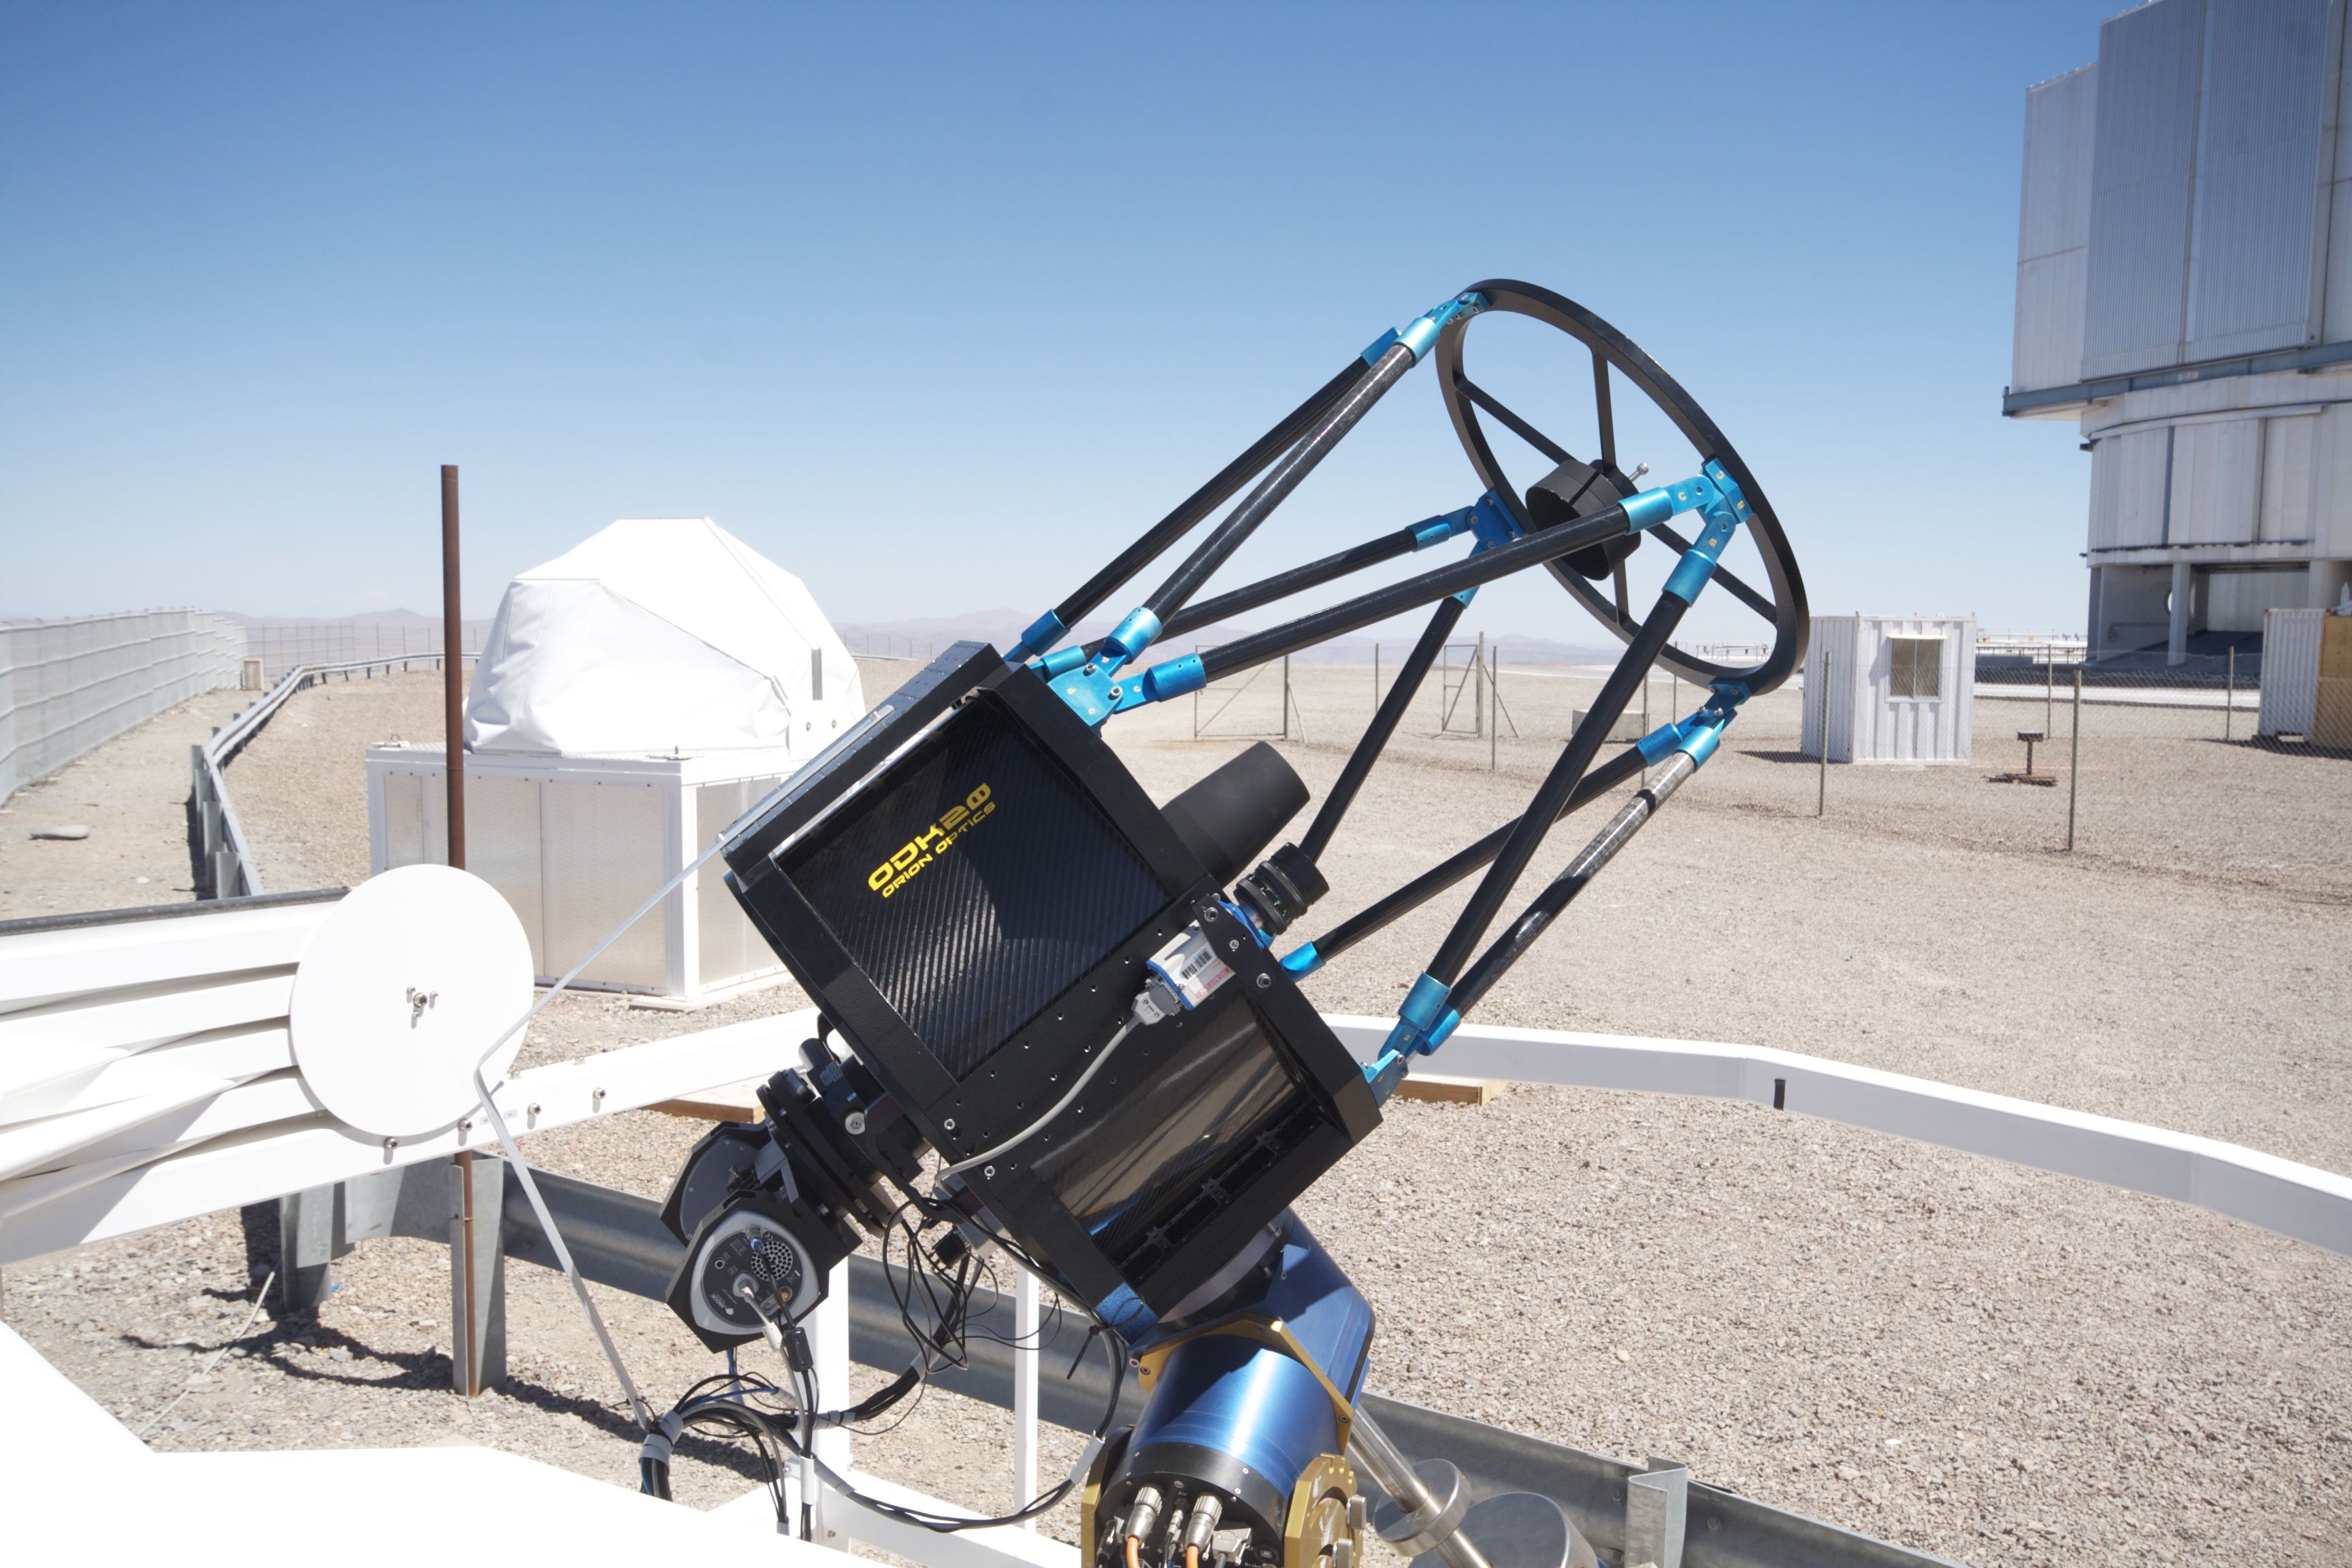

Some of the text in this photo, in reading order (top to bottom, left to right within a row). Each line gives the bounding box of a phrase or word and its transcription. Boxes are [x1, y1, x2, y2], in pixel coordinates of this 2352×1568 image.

[868, 783, 991, 891] ODK20
[882, 802, 996, 898] ORION OPTICS
